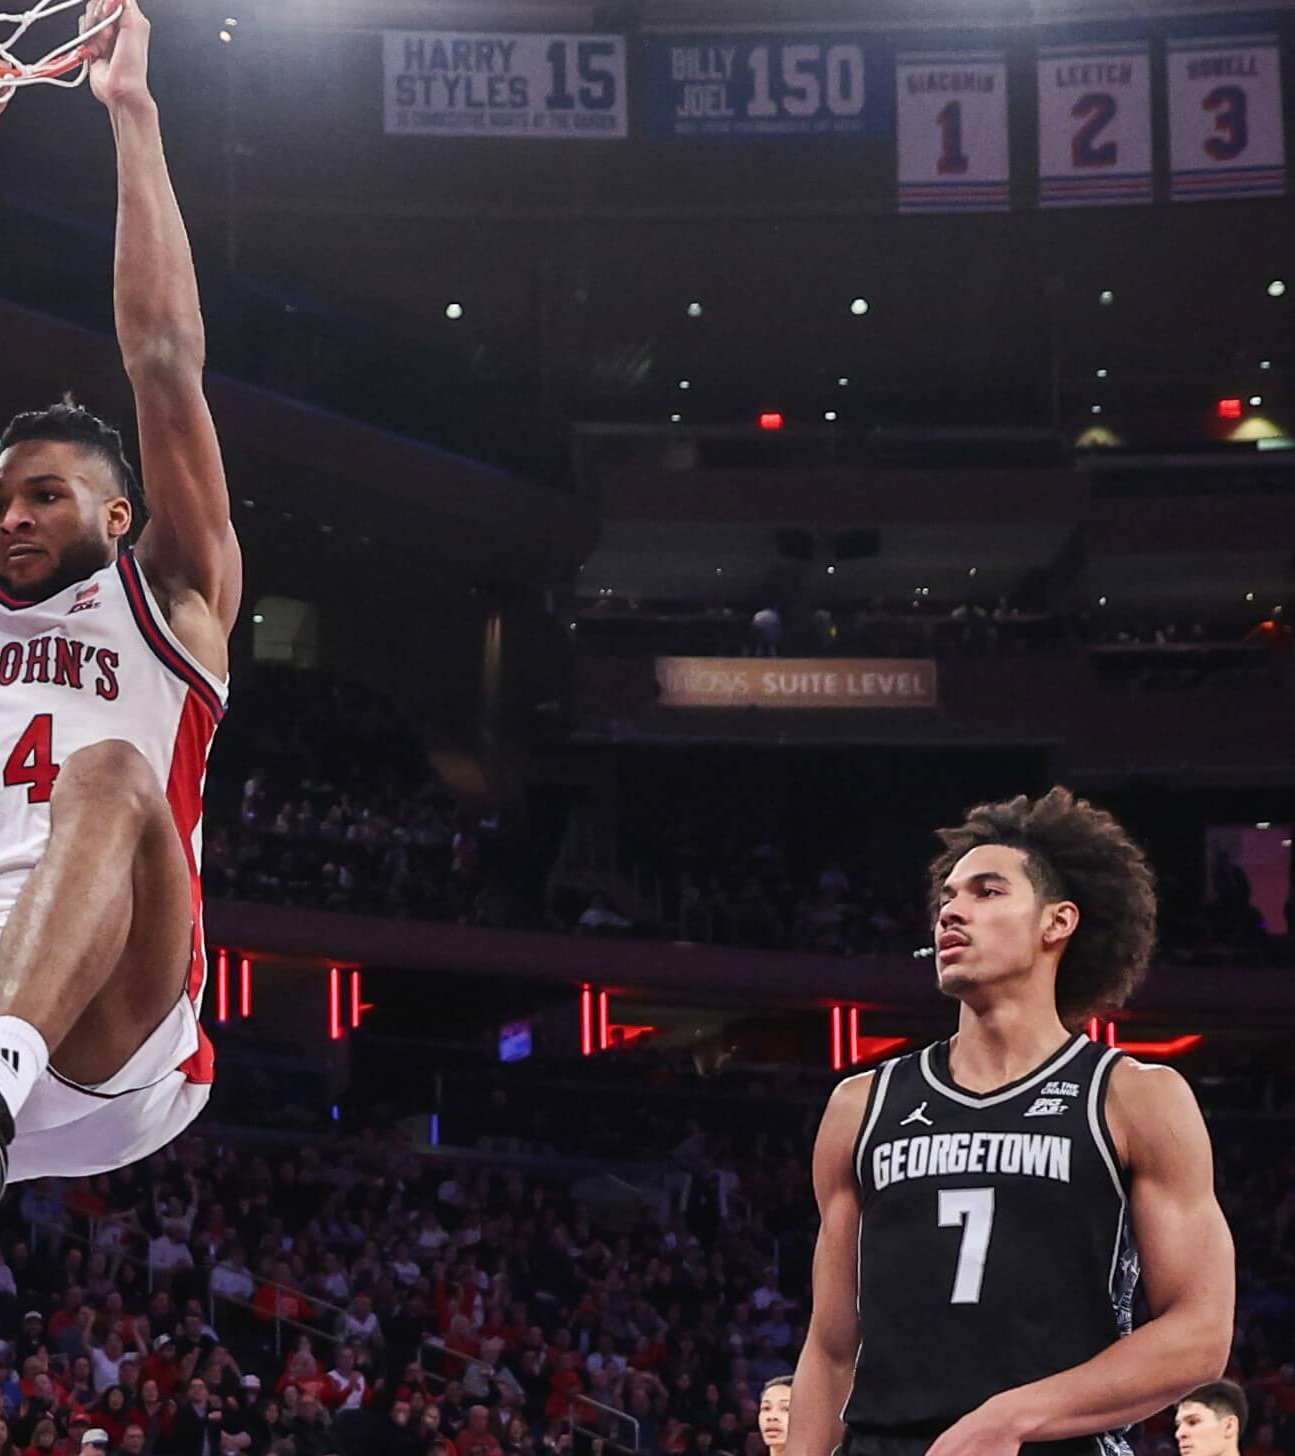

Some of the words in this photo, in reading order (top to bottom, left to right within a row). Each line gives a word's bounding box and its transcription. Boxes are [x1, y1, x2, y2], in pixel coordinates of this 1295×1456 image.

[403, 38, 517, 72] HARRY
[544, 40, 616, 110] 15
[671, 46, 737, 80] BILLY
[747, 44, 865, 116] 150
[1055, 62, 1133, 88] LEETCH
[395, 74, 529, 108] STYLES
[676, 83, 734, 117] JOEL
[936, 100, 969, 175] 1
[1071, 92, 1118, 168] 2
[1202, 84, 1249, 161] 3
[762, 672, 837, 695] SUITE
[848, 673, 926, 695] LEVEL
[872, 1132, 1071, 1191] GEORGETOWN
[937, 1187, 995, 1304] 7
